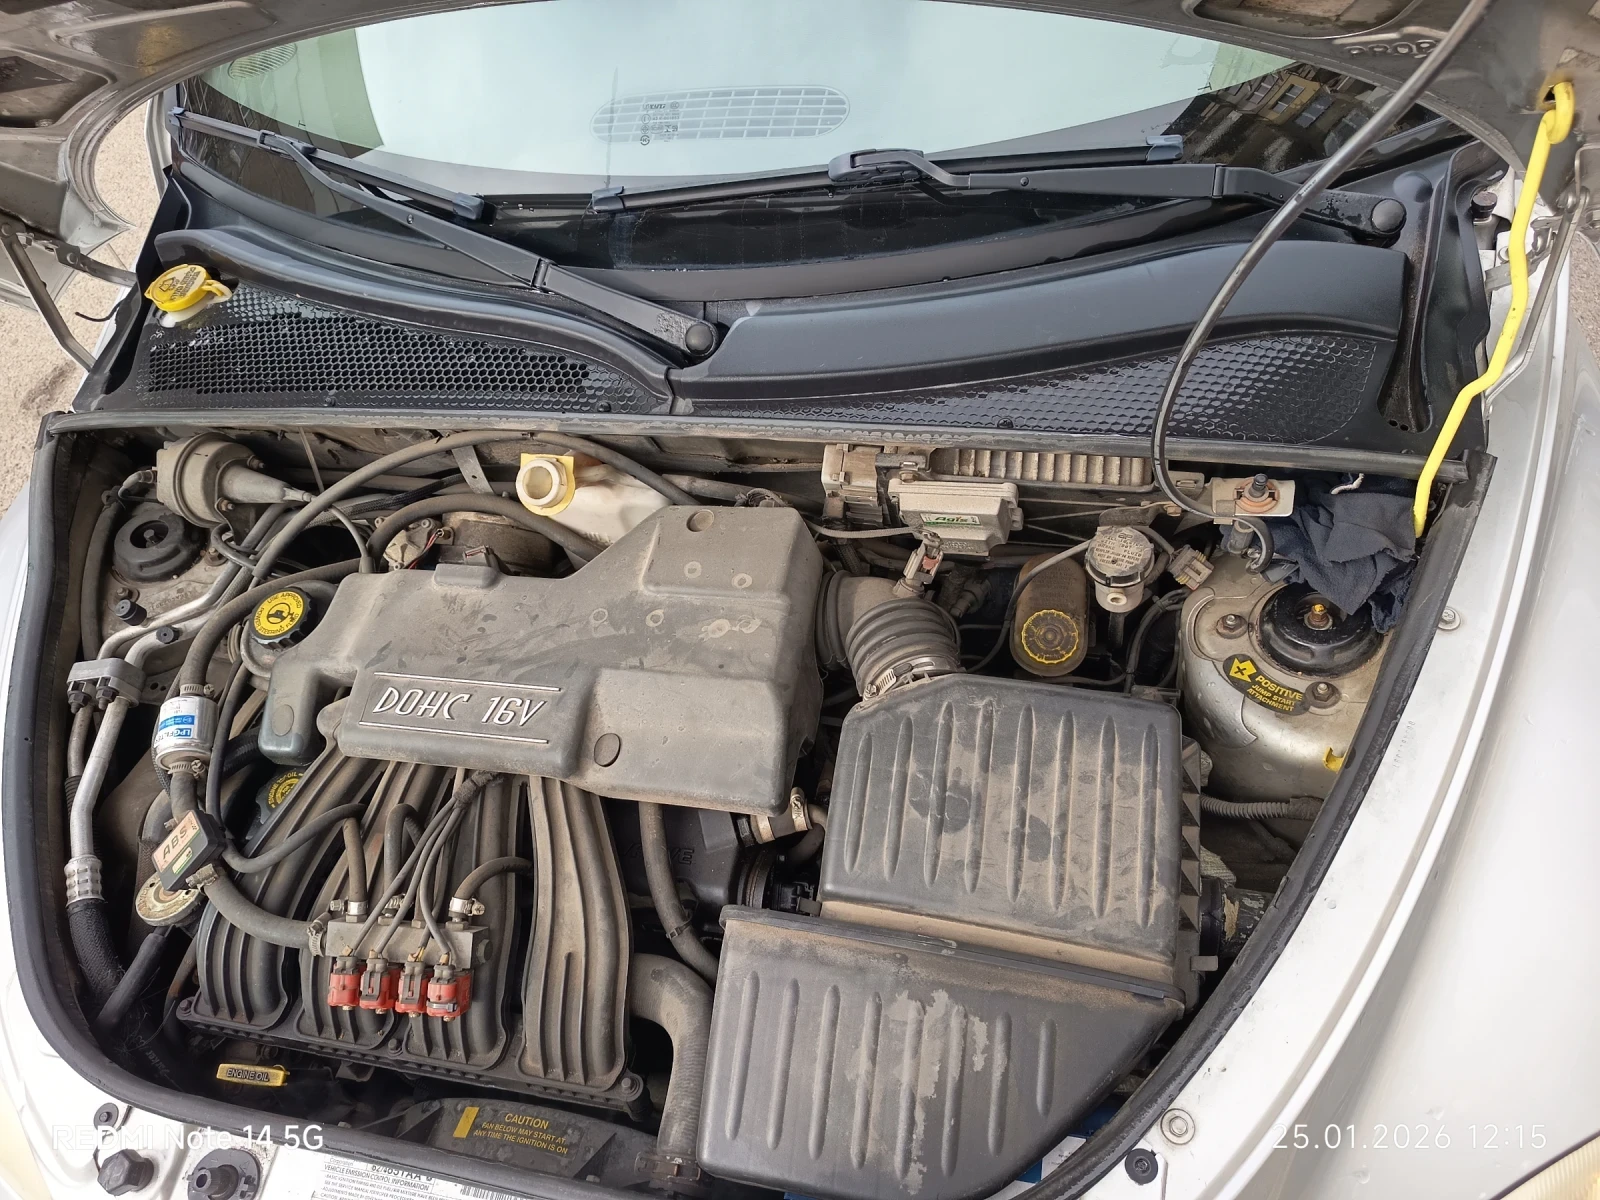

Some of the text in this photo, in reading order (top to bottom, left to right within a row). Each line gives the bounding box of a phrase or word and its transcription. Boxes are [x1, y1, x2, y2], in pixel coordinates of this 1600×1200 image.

[280, 592, 302, 609] APPROVED
[1246, 688, 1295, 712] ATTACHMENT
[1251, 684, 1296, 706] JUMP START
[1255, 675, 1303, 701] POSITIVE
[372, 686, 547, 727] DOHC 16V
[163, 825, 187, 860] ABS
[226, 1068, 270, 1082] ENGINE OIL
[481, 1122, 566, 1145] FAN BELOW MAY START AT
[504, 1113, 550, 1130] CAUTION
[473, 1129, 487, 1137] ANY
[487, 1131, 502, 1139] TIME
[503, 1134, 516, 1142] THE
[516, 1136, 548, 1149] IGNITION
[556, 1146, 569, 1155] ON
[324, 1164, 345, 1174] VEHICLE
[345, 1169, 371, 1179] EMISSION
[370, 1173, 391, 1184] CONTROL
[391, 1177, 430, 1191] INFORMATION
